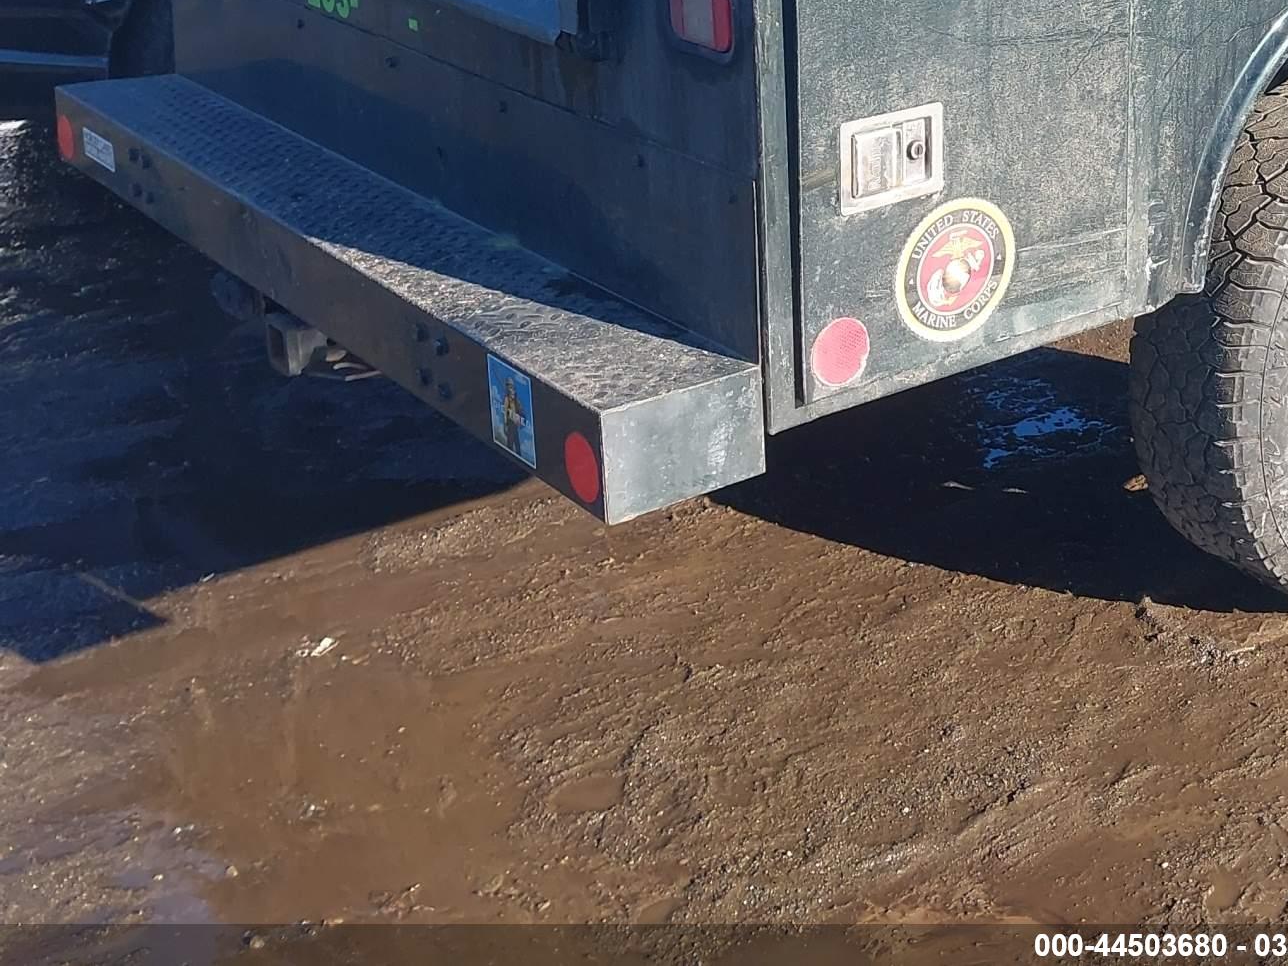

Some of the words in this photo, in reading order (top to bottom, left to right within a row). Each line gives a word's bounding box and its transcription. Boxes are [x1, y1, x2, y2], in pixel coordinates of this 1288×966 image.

[911, 214, 954, 260] UNITED
[961, 210, 999, 240] STATES
[911, 300, 957, 328] MARINE
[963, 280, 998, 320] CORPS
